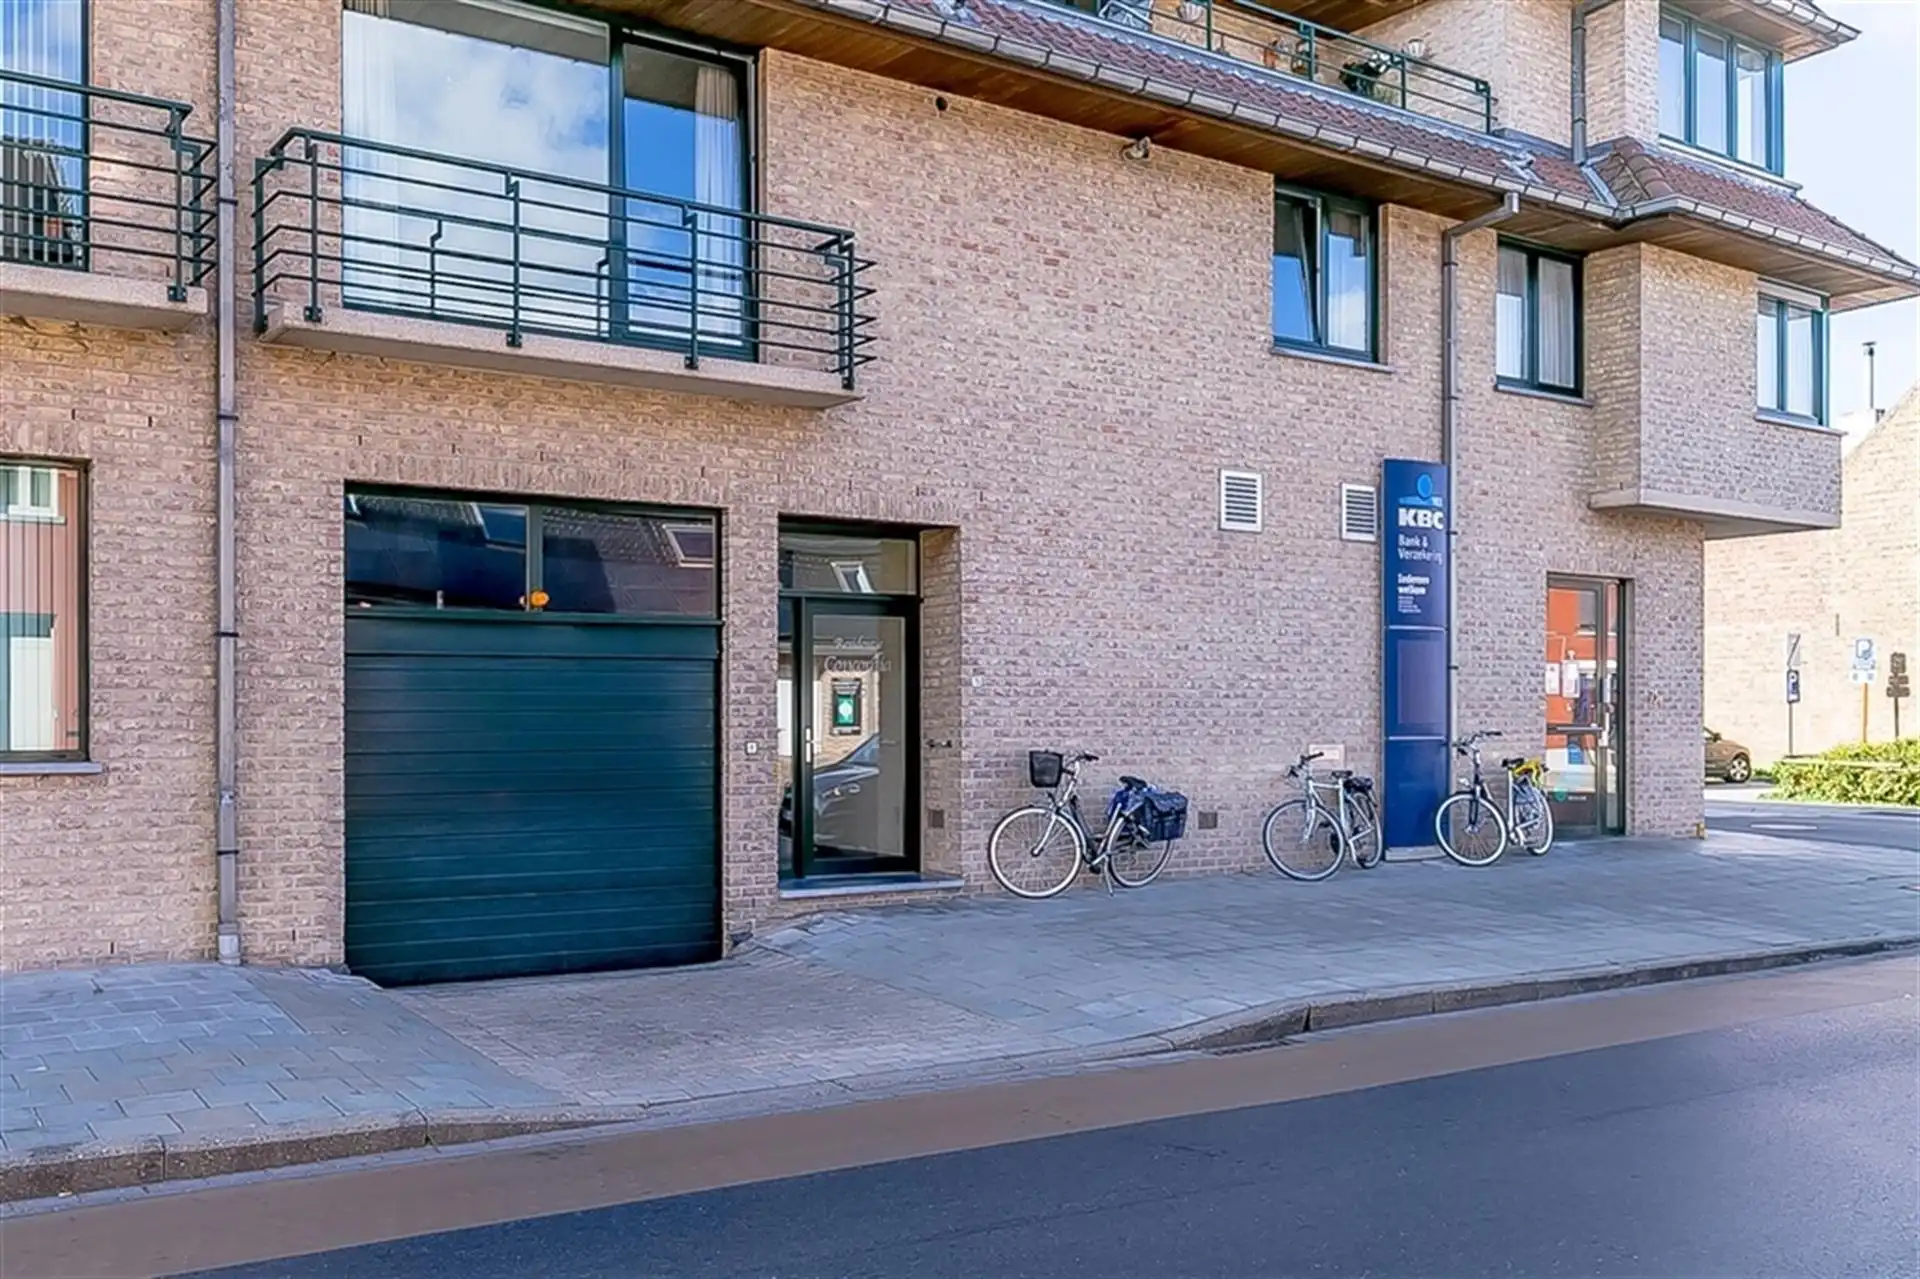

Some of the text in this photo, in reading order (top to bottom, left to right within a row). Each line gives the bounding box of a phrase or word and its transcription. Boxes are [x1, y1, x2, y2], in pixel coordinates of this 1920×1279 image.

[1398, 507, 1444, 530] KBC
[1398, 533, 1429, 548] Bank &
